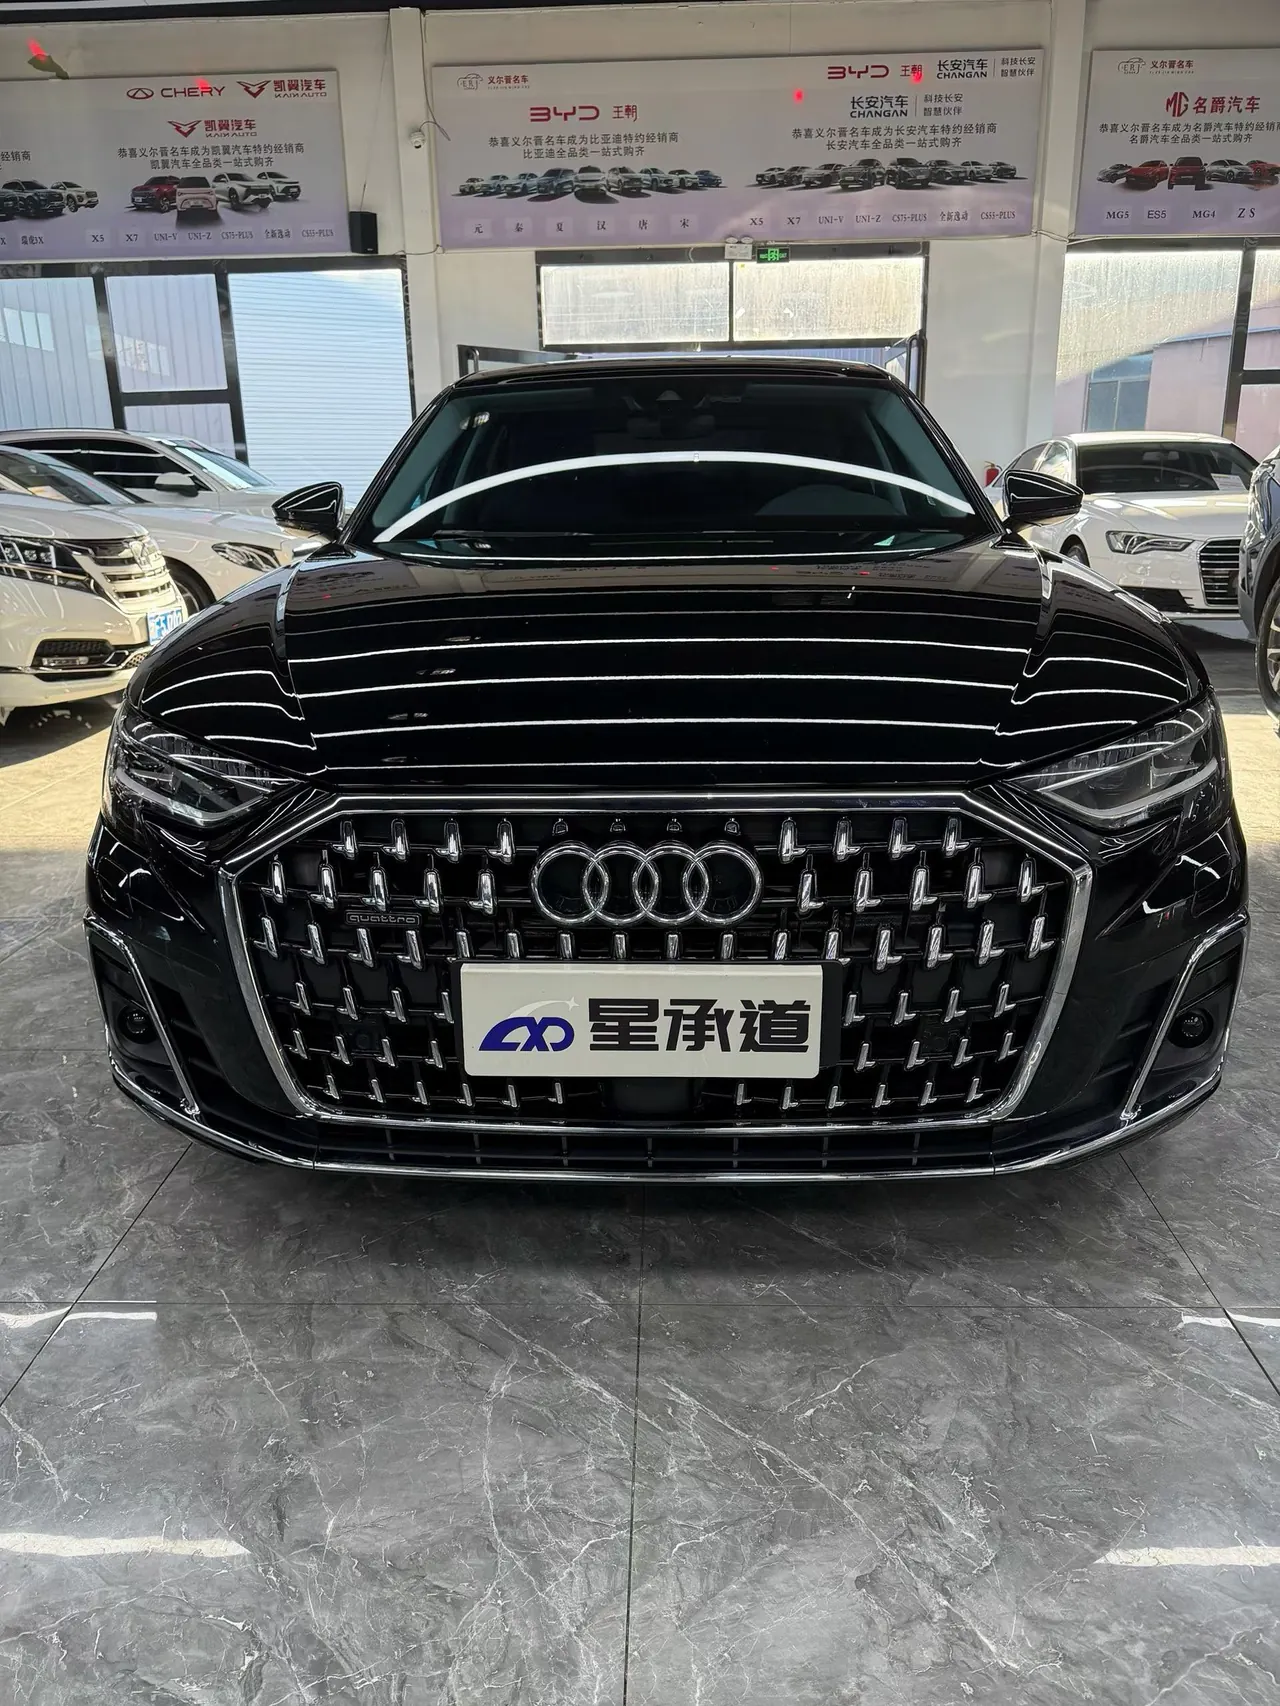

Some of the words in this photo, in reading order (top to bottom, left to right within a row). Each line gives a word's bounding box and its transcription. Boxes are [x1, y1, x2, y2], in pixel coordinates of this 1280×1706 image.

[937, 58, 988, 72] 长安汽车
[1001, 56, 1036, 66] 科技长安
[827, 64, 890, 80] BYD
[900, 64, 923, 79] 王朝
[937, 70, 988, 80] CHANGAN
[1000, 67, 1035, 78] 智慧伙伴
[273, 79, 325, 92] 凯翼汽车
[161, 86, 225, 98] CHERY
[924, 93, 963, 103] 科技长安
[851, 95, 909, 110] 长安汽车
[1166, 92, 1189, 117] MG
[1192, 95, 1261, 114] 名爵汽车
[530, 105, 600, 122] BYD
[612, 104, 638, 122] 王朝
[850, 109, 908, 119] CHANGAN
[923, 106, 963, 117] 智慧伙伴
[204, 119, 257, 132] 凯翼汽车
[826, 137, 962, 151] 长安汽车全品类一站式购齐
[1129, 133, 1253, 145] 名爵汽车全品类一站式购齐
[523, 146, 645, 160] 比亚迪全品类一站式购齐
[150, 156, 274, 170] 凯翼汽车全品类一站式购齐
[750, 217, 764, 226] X5
[787, 216, 801, 225] X7
[818, 215, 844, 225] UNI-V
[855, 214, 881, 224] UNI-Z
[1106, 211, 1130, 219] MG5
[1147, 209, 1167, 219] ES5
[1192, 210, 1216, 219] MG4
[473, 223, 484, 234] 元
[514, 222, 524, 233] 秦
[555, 221, 564, 232] 夏
[596, 220, 606, 231] 汉
[638, 219, 649, 230] 唐
[679, 218, 690, 228] 宋
[91, 234, 105, 243] X5
[125, 233, 139, 242] X7
[349, 915, 416, 923] quattro
[588, 998, 811, 1053] 星承道
